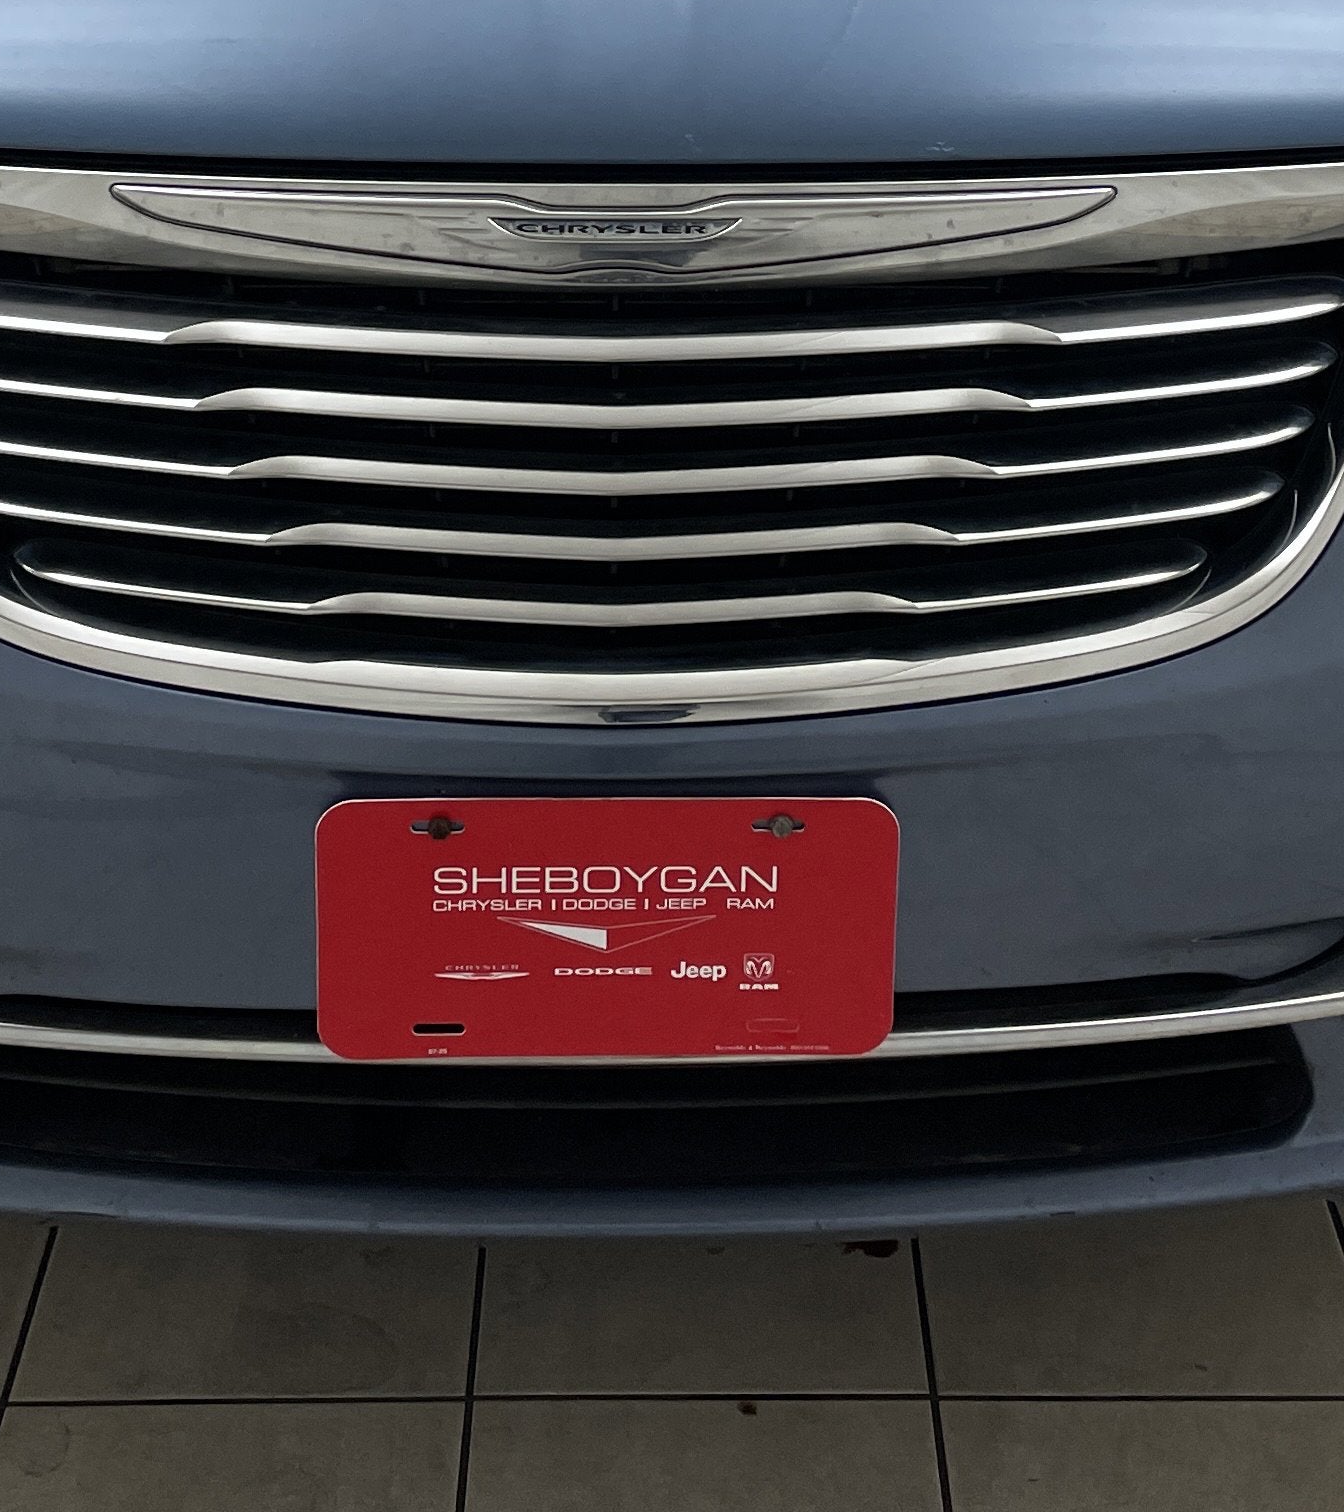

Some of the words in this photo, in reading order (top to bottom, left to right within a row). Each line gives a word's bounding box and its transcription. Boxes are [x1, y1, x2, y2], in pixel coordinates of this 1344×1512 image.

[515, 223, 707, 235] CHRYSLER
[433, 865, 778, 895] SHEBOYGAN
[432, 899, 543, 912] CHRYSLER
[562, 898, 637, 911] DODGE
[655, 898, 707, 910] JEEP
[726, 897, 774, 910] RAM
[554, 967, 653, 976] DODGE
[670, 961, 727, 981] Jeep
